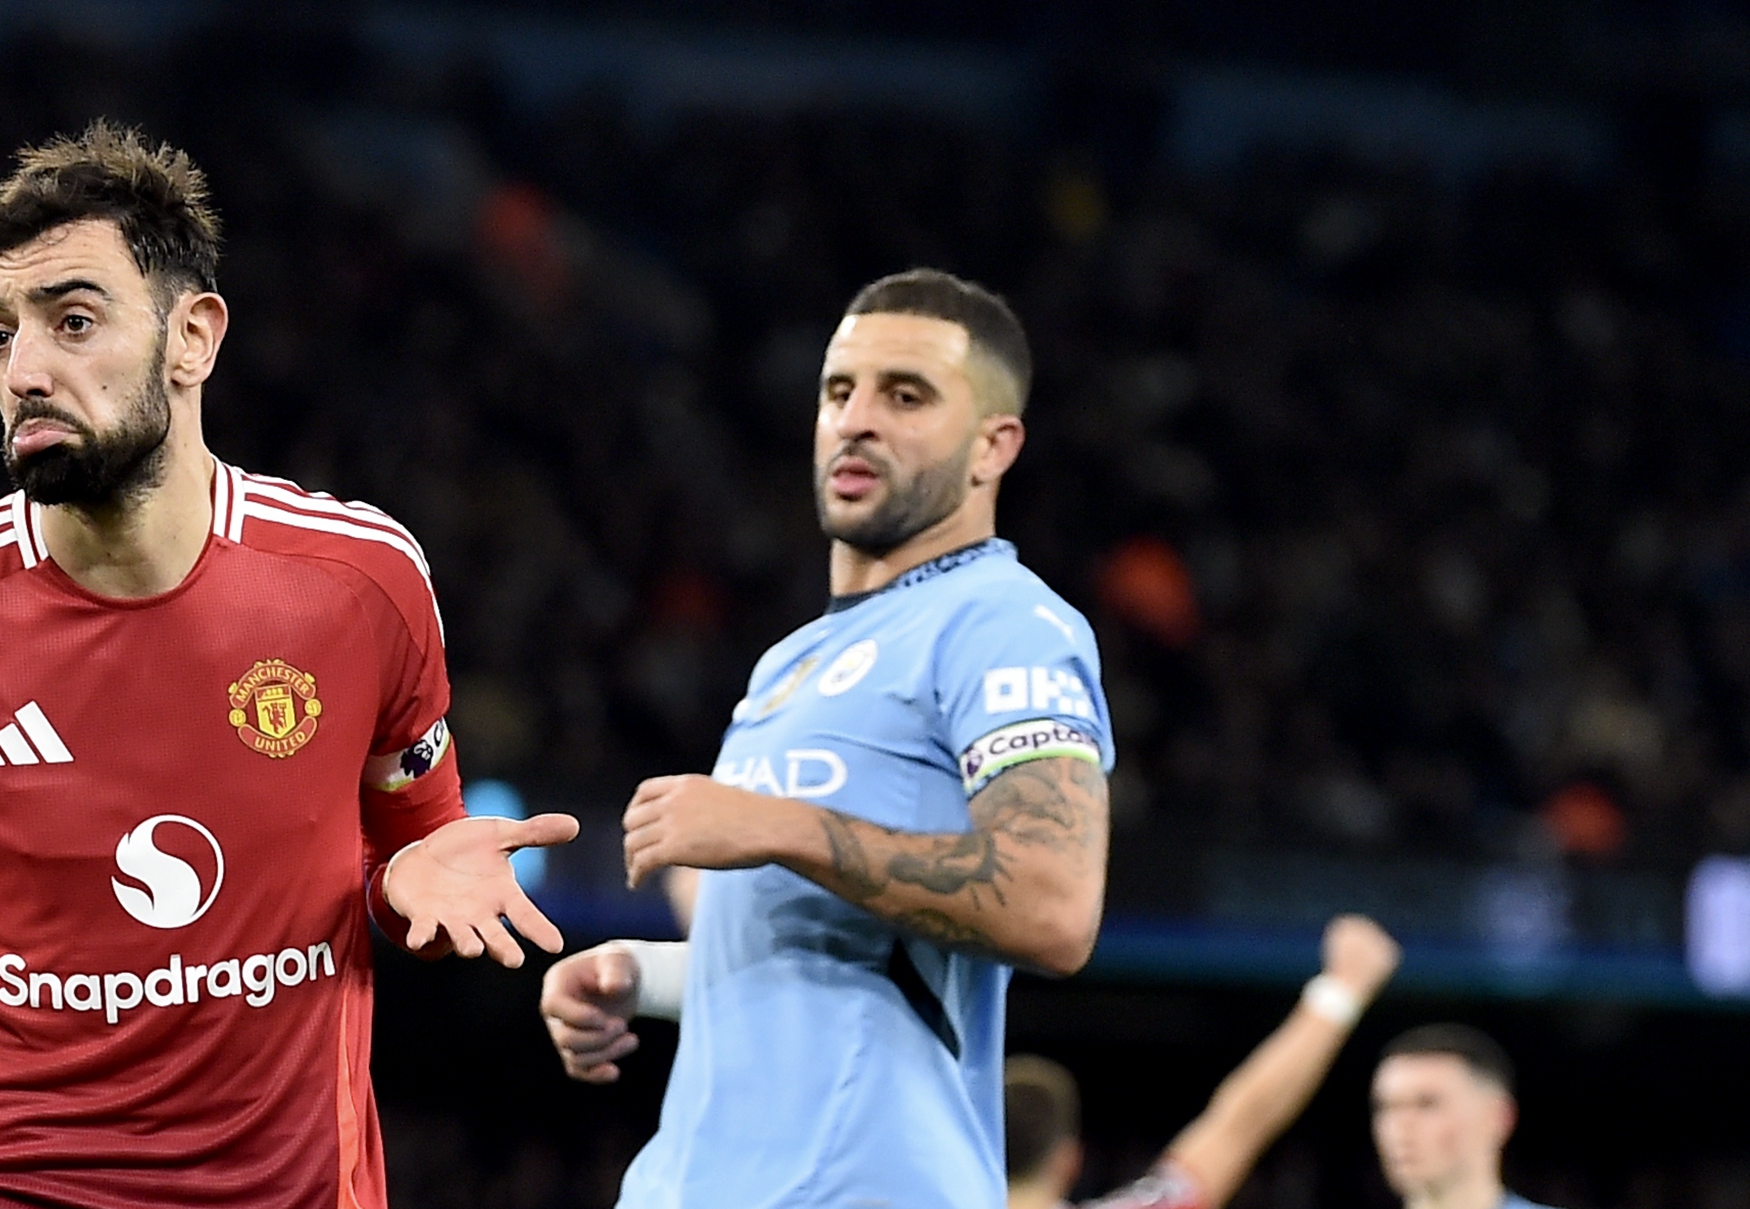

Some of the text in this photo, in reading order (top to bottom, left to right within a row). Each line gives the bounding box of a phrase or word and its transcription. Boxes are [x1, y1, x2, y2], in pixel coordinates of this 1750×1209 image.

[235, 666, 310, 703] MANCHESTER
[254, 730, 306, 752] UNITED
[989, 728, 1084, 756] Capta
